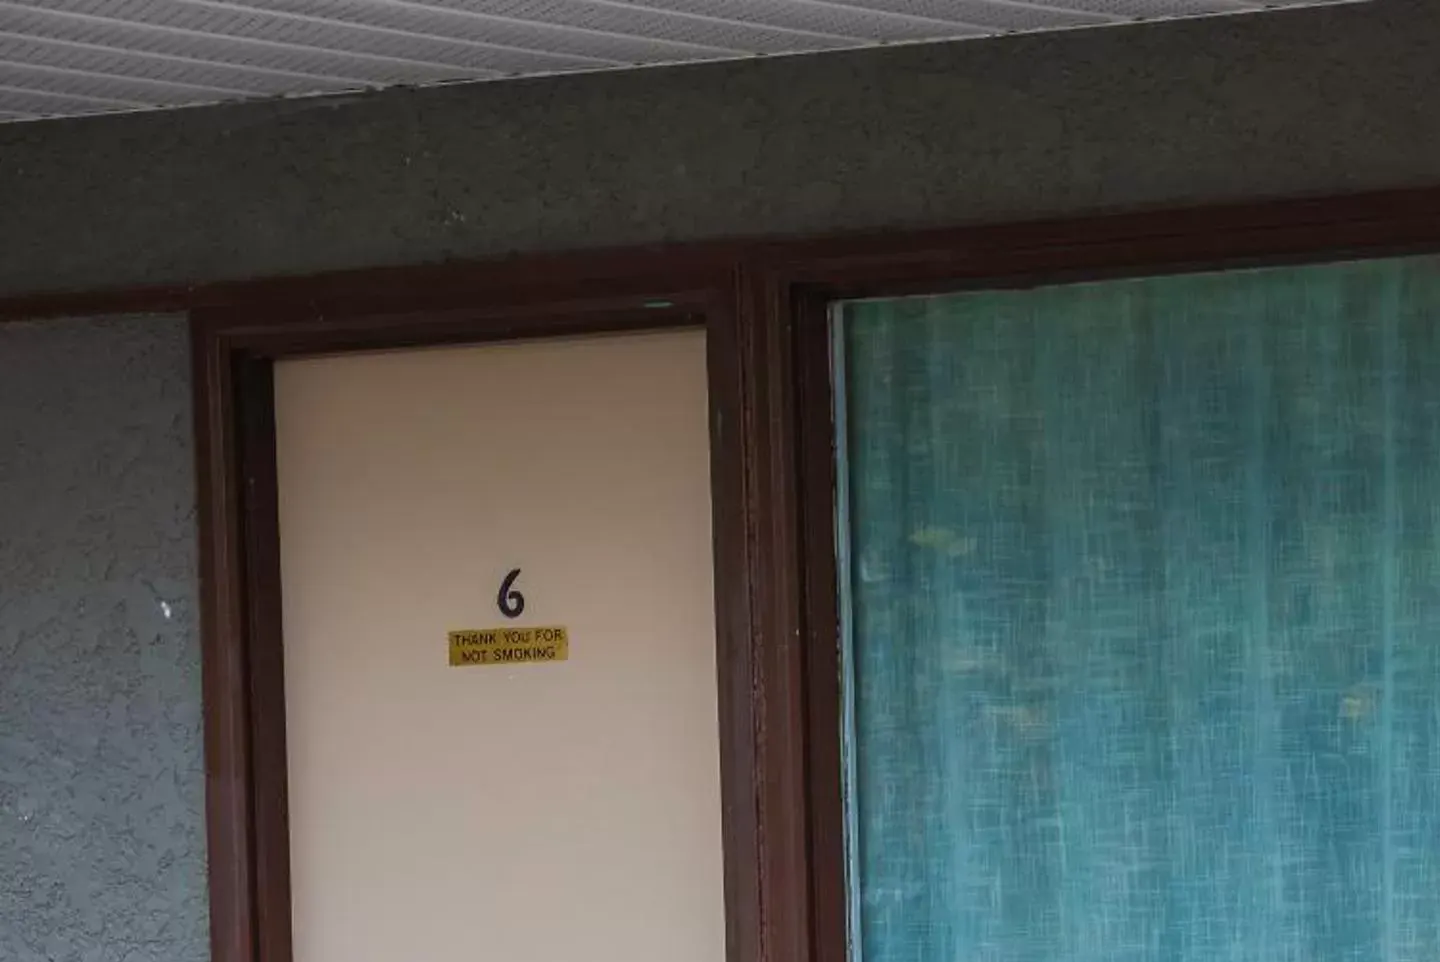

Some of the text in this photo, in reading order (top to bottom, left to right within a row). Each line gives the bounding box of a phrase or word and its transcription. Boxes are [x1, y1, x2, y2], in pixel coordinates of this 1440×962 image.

[497, 568, 525, 618] 6
[455, 629, 563, 646] THANK YOU FOR
[461, 646, 556, 664] NOT SMOKING
